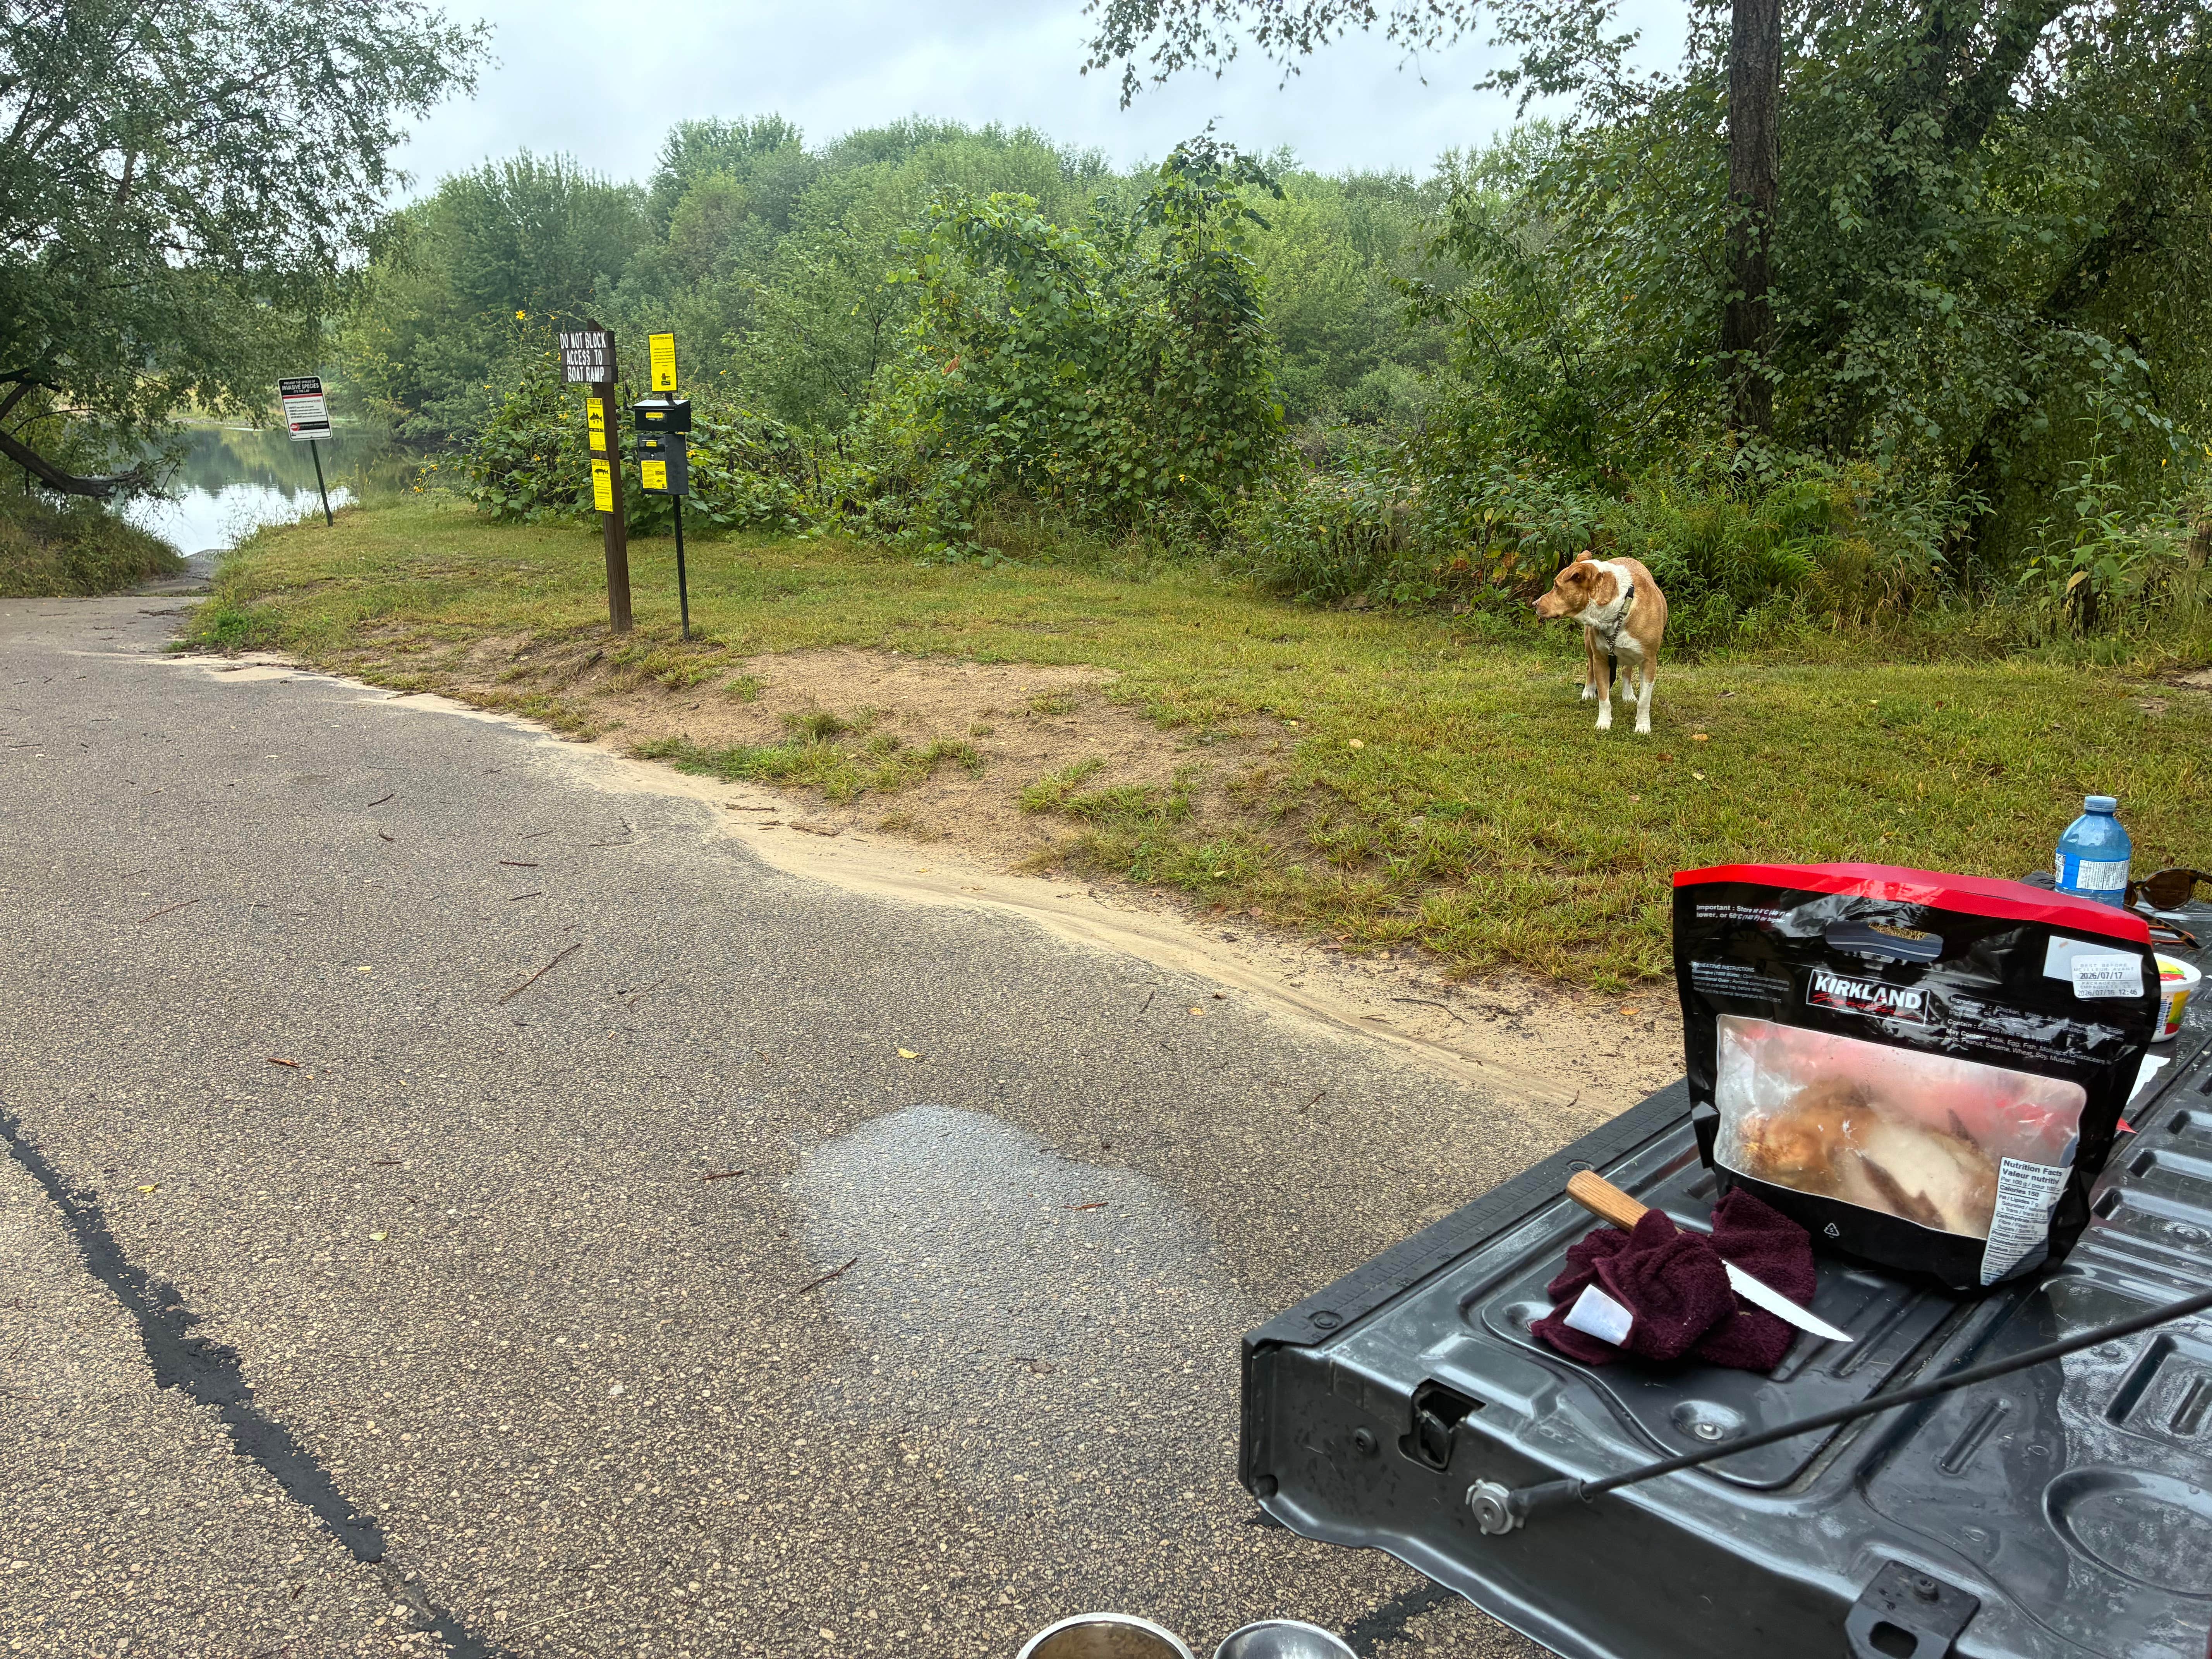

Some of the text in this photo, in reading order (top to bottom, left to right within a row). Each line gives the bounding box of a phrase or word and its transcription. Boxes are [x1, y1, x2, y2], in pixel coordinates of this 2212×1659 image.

[560, 332, 606, 349] DO NOT BLOCK
[567, 349, 603, 366] ACCESS TO
[567, 366, 604, 383] BOAT RAMP
[1815, 975, 1922, 1009] KIRKLAND
[1950, 996, 1986, 1008] Ingredients
[1948, 1019, 1973, 1028] Contain
[1977, 1024, 2000, 1033] Sulfites
[2007, 1039, 2021, 1048] Egg,
[1985, 1042, 2011, 1053] Sesame,
[2035, 1052, 2049, 1060] Soy,
[2050, 1055, 2077, 1065] Mustard.
[2002, 1168, 2030, 1179] Valeur
[2003, 1159, 2063, 1176] Nutrition Facts
[2000, 1185, 2026, 1195] Calories
[2010, 1196, 2030, 1205] Lipides
[1996, 1212, 2029, 1223] Carbohydrate
[1989, 1244, 2008, 1252] Sodium
